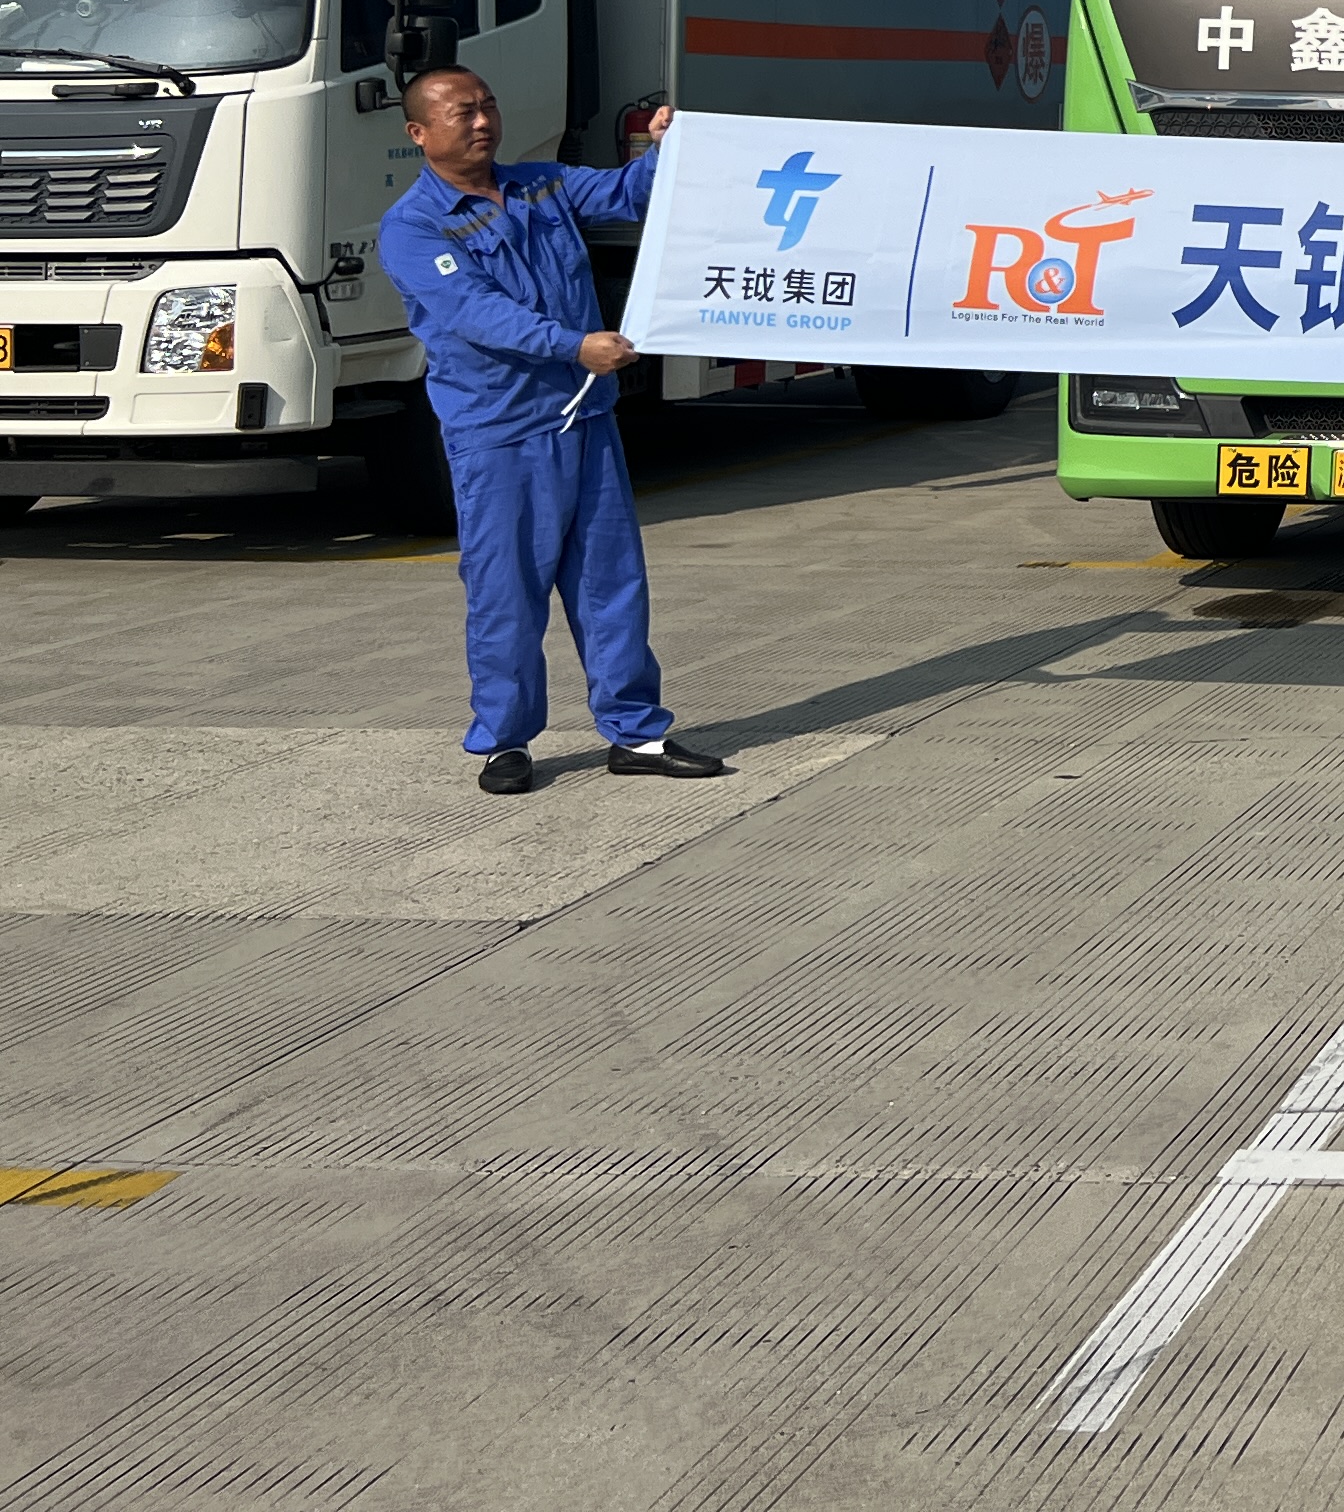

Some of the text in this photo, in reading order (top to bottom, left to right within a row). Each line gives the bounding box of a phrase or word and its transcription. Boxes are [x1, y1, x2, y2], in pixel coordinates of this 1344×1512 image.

[703, 265, 856, 307] 天钺集团
[699, 309, 852, 331] TIANYUE GROUP
[951, 311, 1105, 327] Logistics For The Real World
[1226, 452, 1301, 490] 危险
